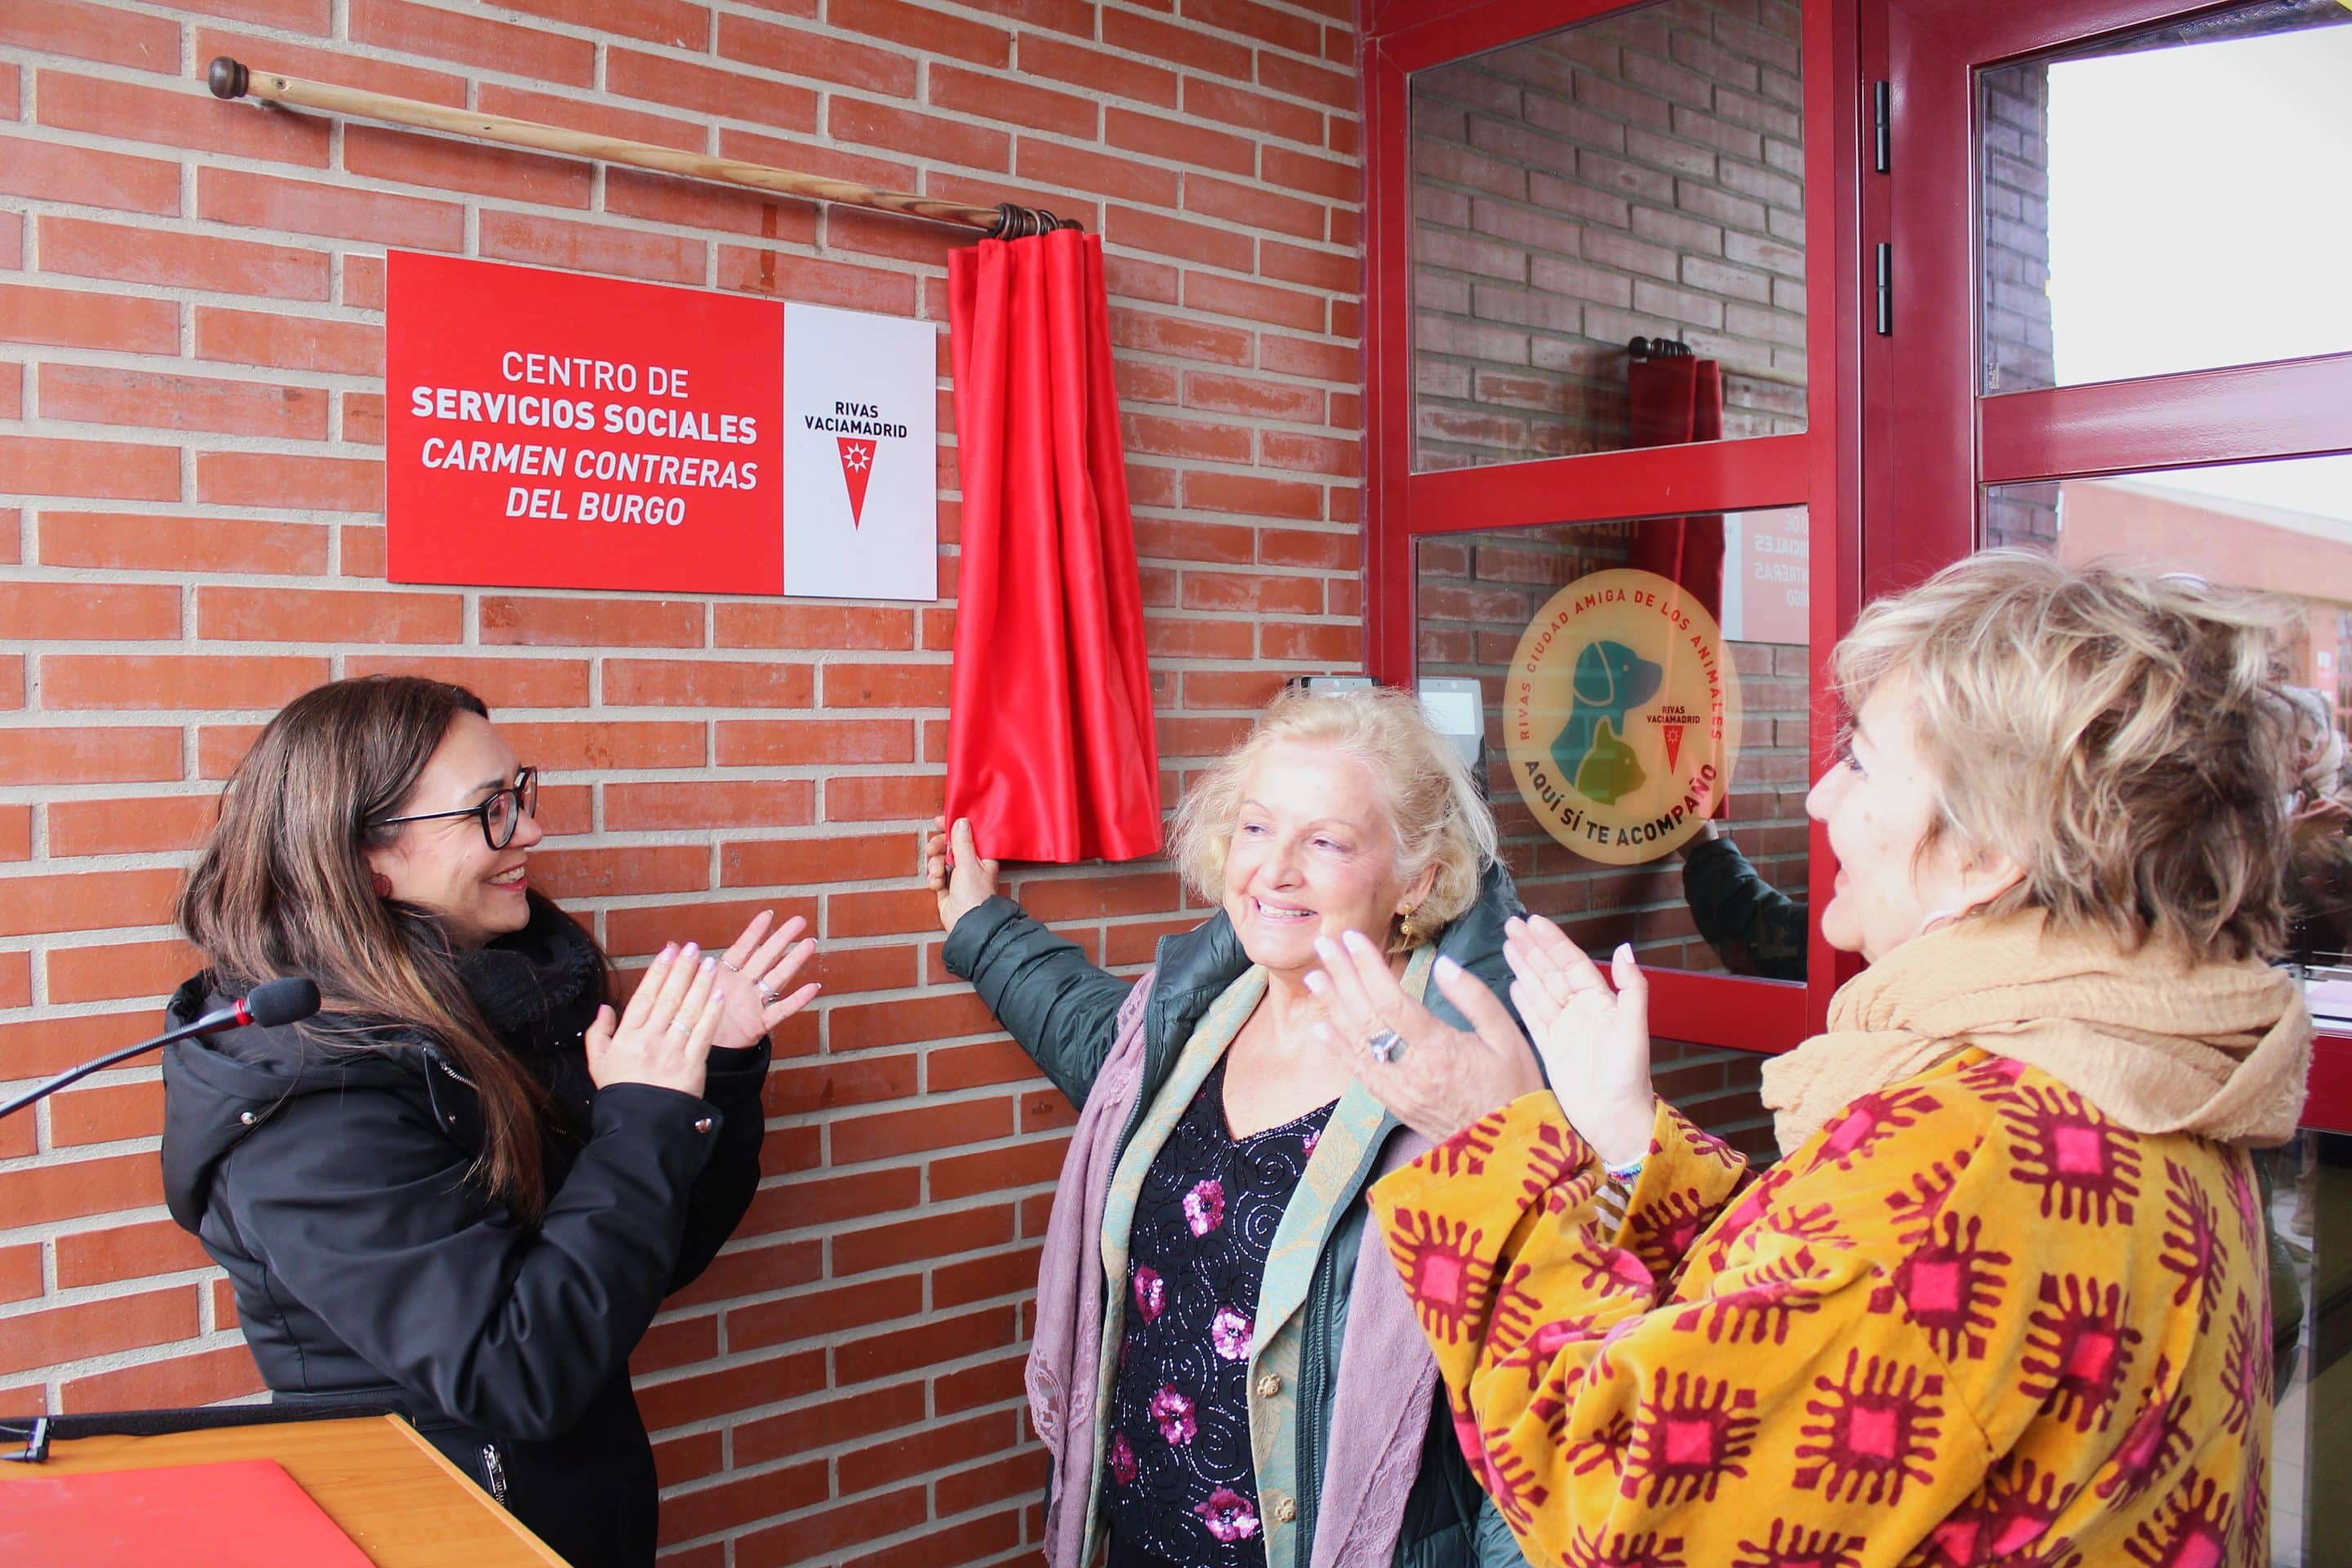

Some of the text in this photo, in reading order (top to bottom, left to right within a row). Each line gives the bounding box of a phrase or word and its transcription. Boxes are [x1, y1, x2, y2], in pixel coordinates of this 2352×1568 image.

[502, 351, 688, 399] CENTRO DE
[411, 385, 757, 444] SERVICIOS SOCIALES
[804, 415, 907, 439] VACIAMADRID
[835, 401, 879, 418] RIVAS
[421, 437, 758, 490] CARMEN CONTRERAS
[506, 487, 685, 526] DEL BURGO
[1518, 588, 1723, 741] RIVAS CIUDAD AMIGA DE LOS ANIMALES
[1646, 715, 1700, 724] VACIAMADRID
[1662, 706, 1685, 715] RIVAS
[1525, 760, 1717, 847] AQUÍ SÍ TE ACOMPAÑO
